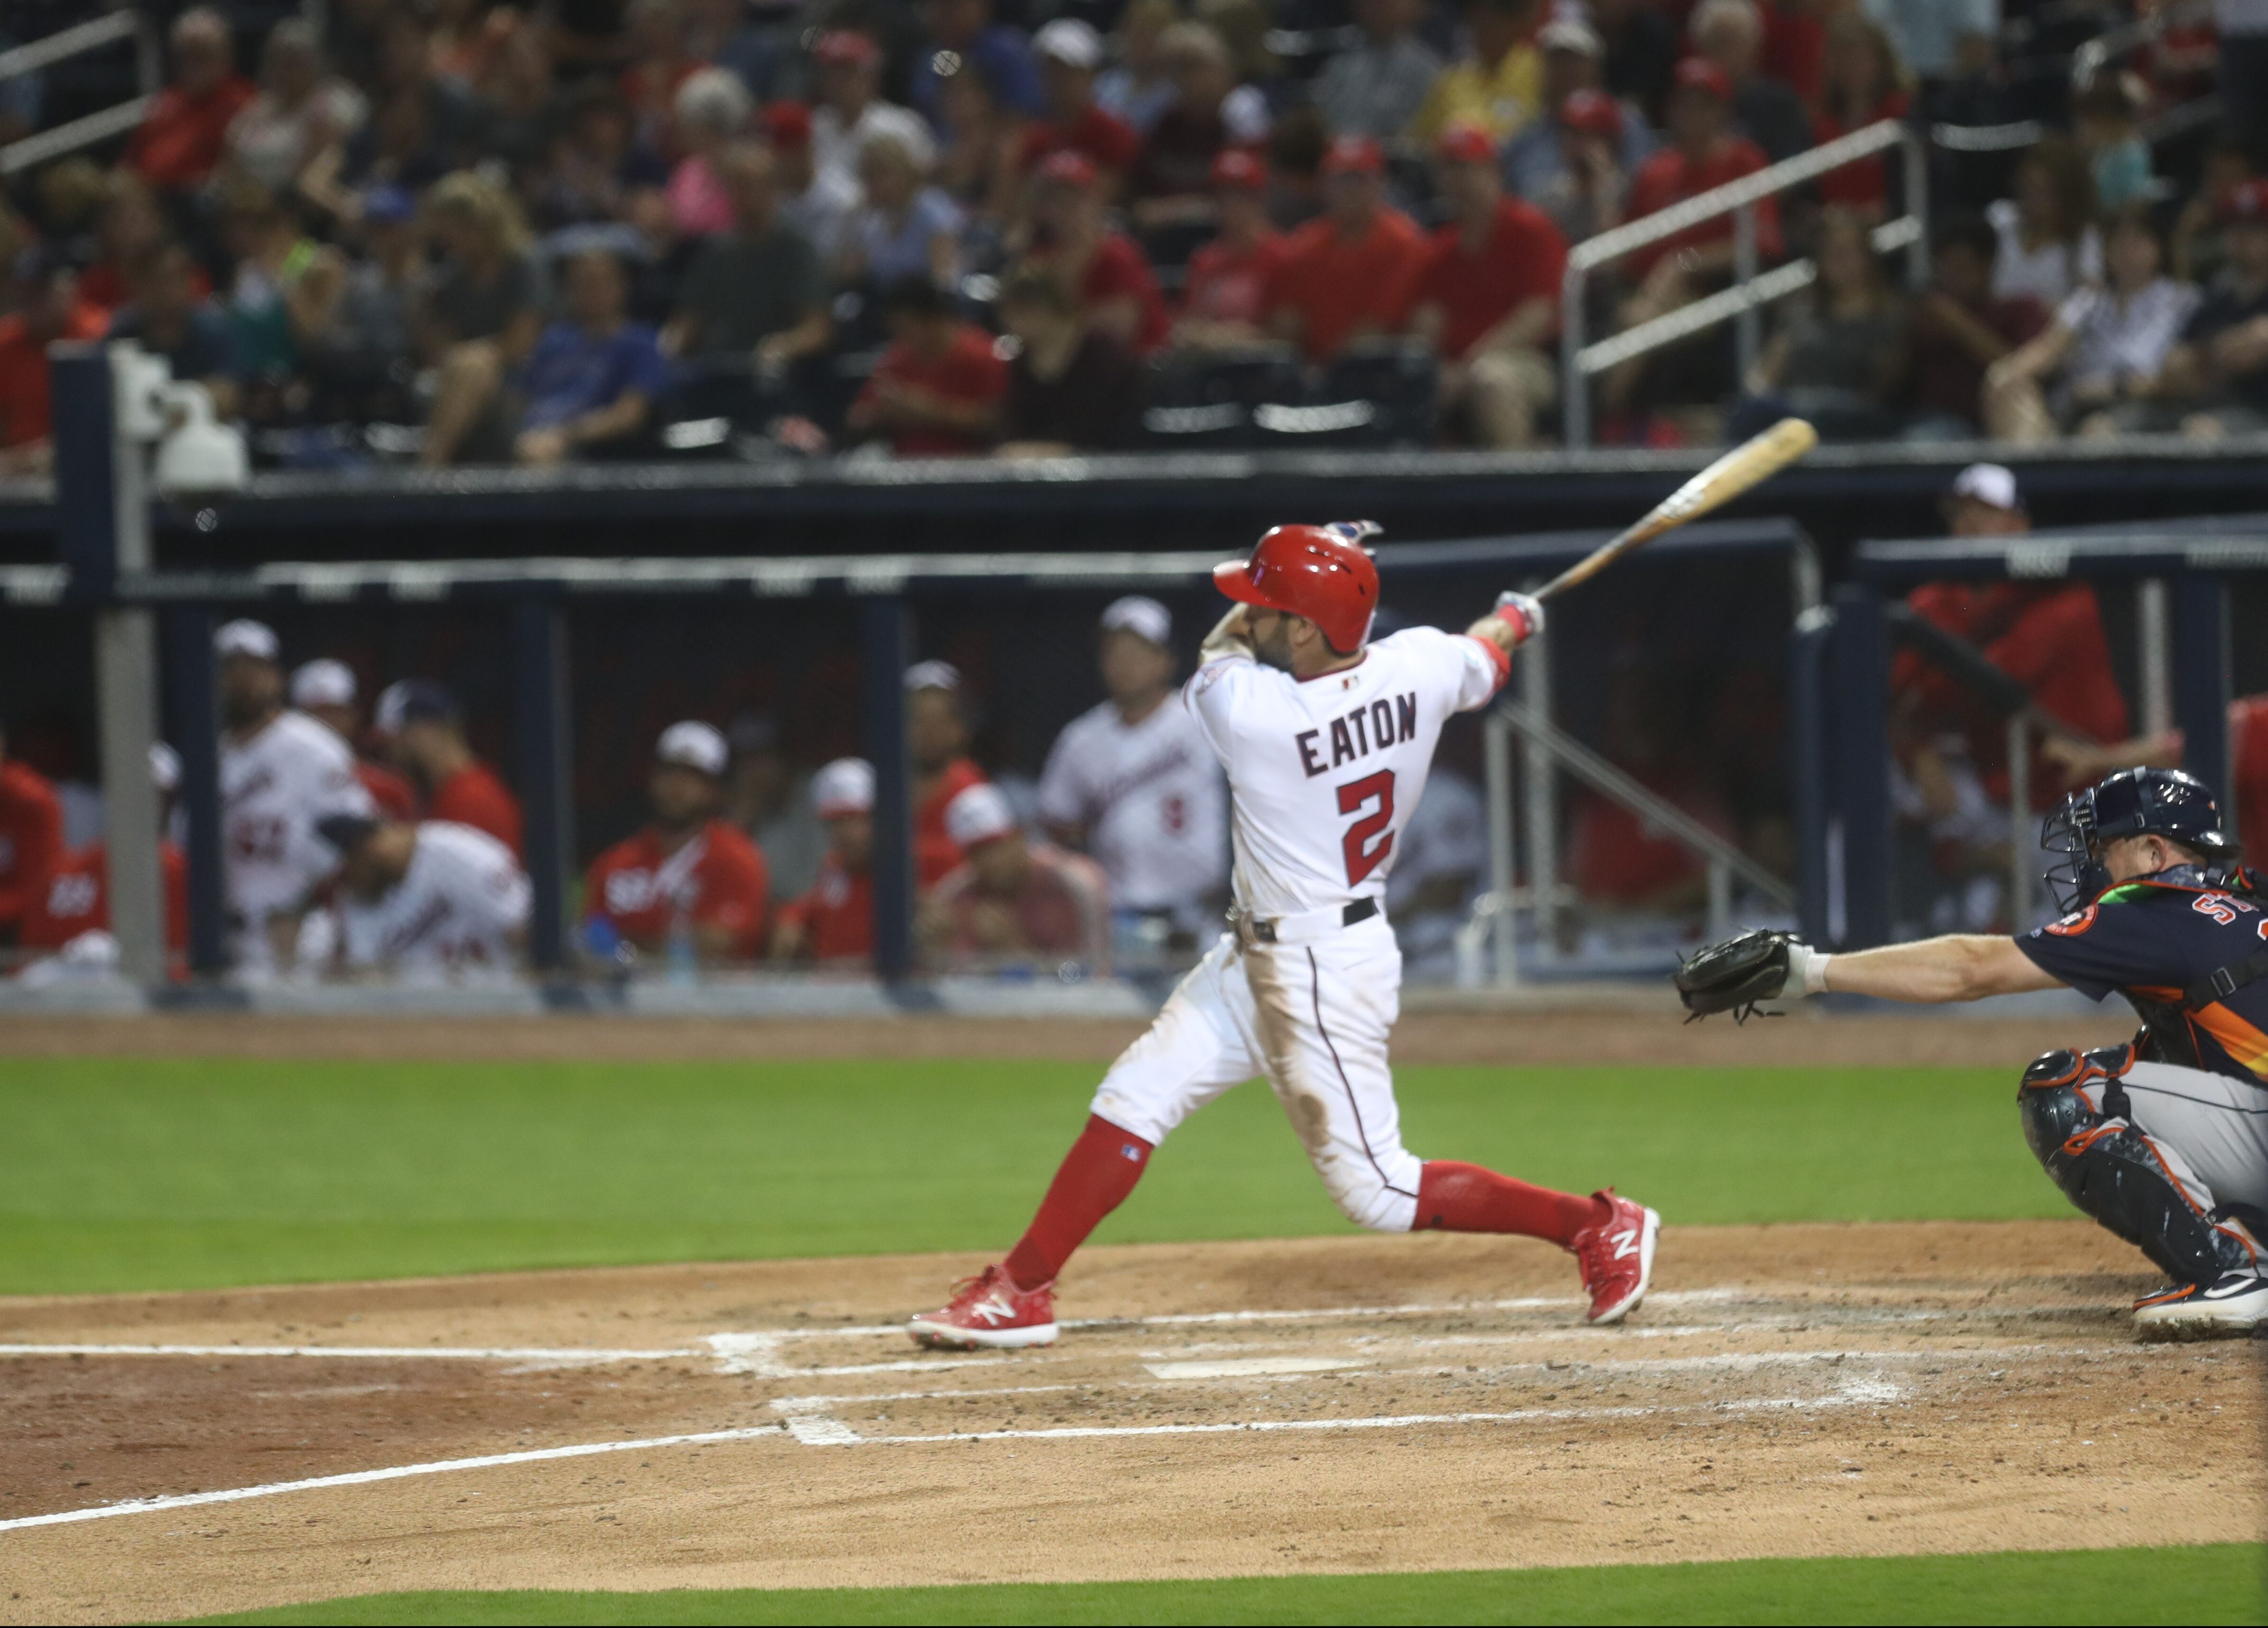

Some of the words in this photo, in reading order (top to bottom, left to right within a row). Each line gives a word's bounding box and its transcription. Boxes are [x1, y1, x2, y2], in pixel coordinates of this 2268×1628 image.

[1294, 691, 1416, 779] EATON
[1335, 767, 1395, 889] 2
[1610, 1228, 1639, 1261] N
[972, 1294, 1016, 1326] N
